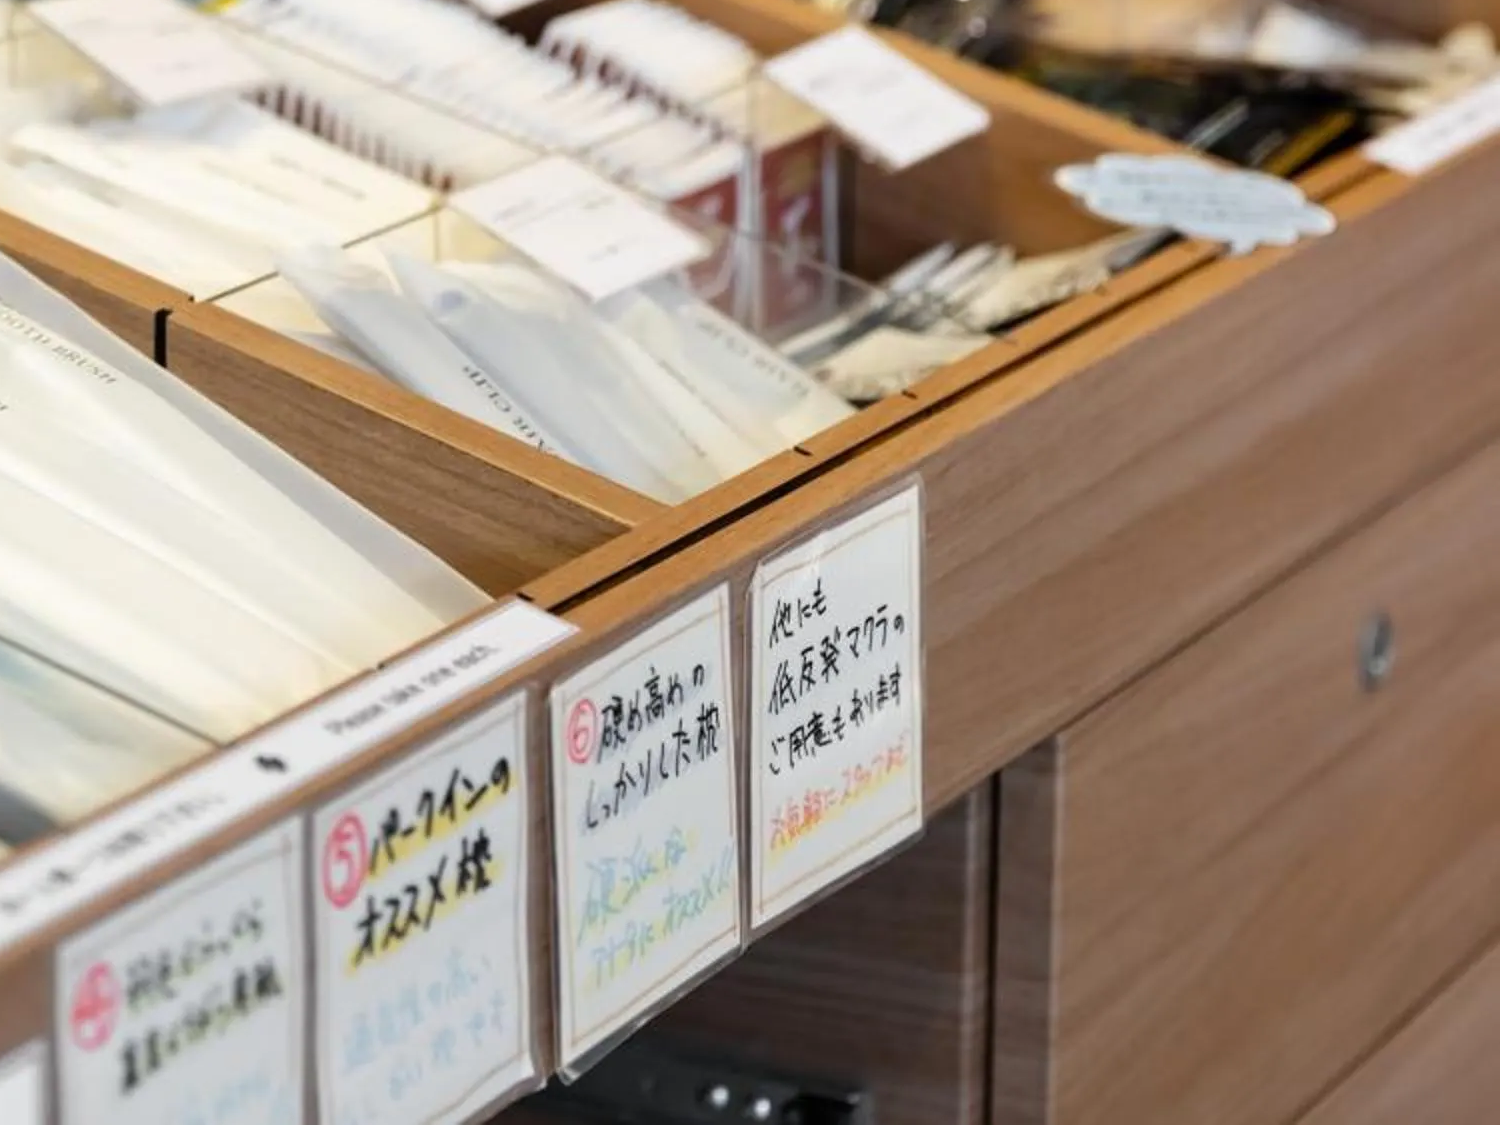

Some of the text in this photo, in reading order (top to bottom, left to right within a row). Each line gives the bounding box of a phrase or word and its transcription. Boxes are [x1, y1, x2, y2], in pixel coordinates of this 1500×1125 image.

[53, 345, 117, 386] BRUSH
[768, 580, 828, 649] 他にも
[768, 605, 905, 716] 低反発マクラの
[585, 702, 720, 829] しっかりした枕
[769, 662, 903, 775] ご用意もあります
